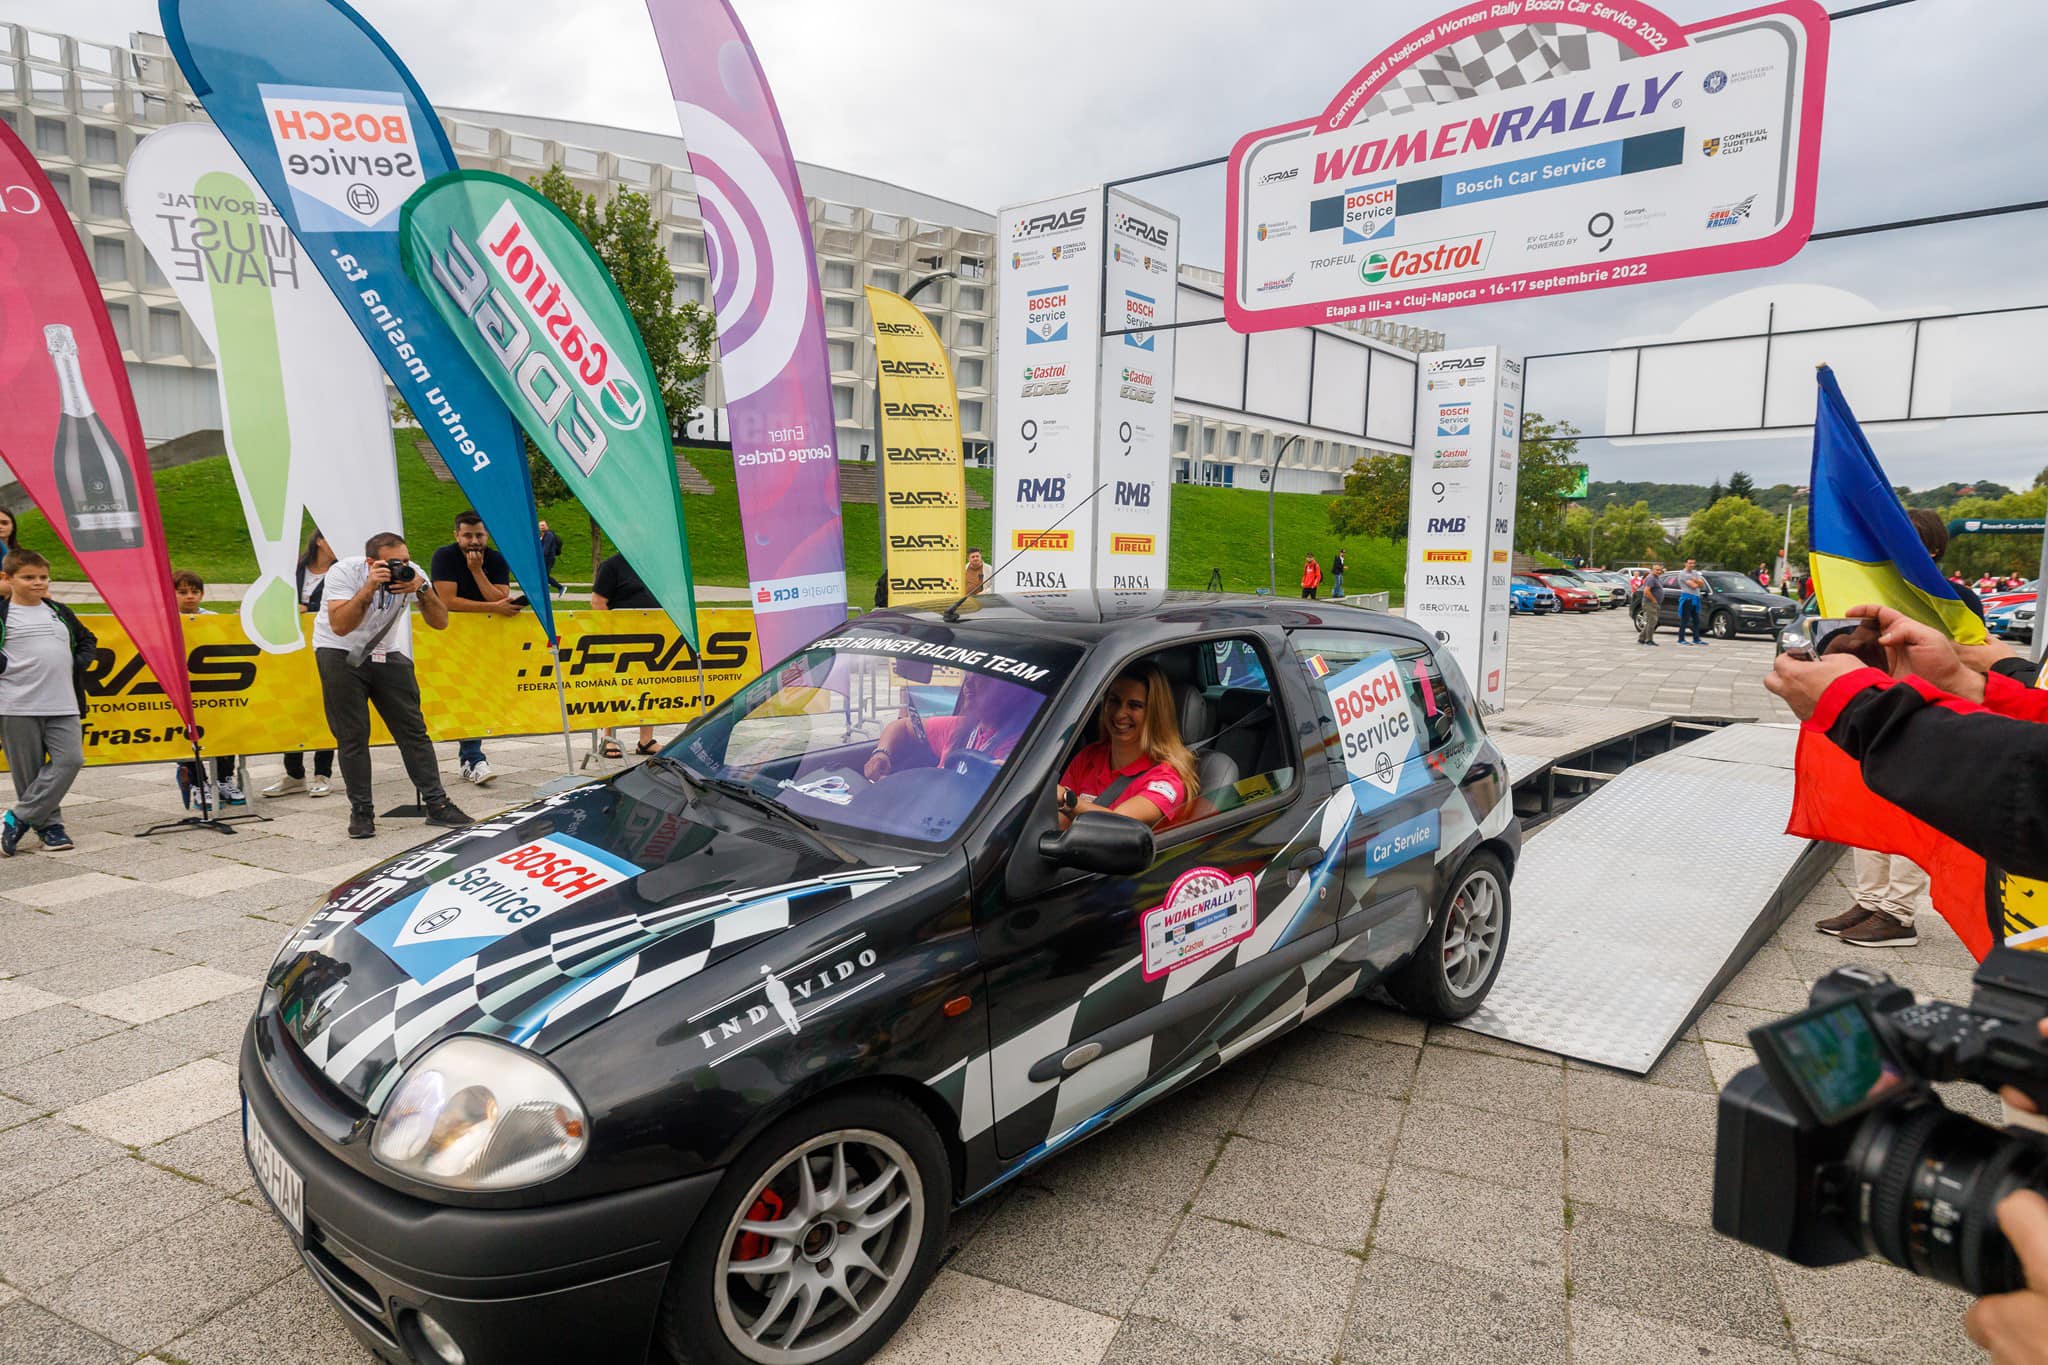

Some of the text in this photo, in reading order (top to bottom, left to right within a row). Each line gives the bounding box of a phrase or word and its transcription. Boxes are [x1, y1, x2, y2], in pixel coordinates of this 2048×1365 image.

[1329, 62, 1387, 128] Campionatul
[1437, 10, 1487, 36] Women
[1491, 1, 1521, 18] Rally
[1525, 0, 1564, 12] Bosch
[1567, 1, 1588, 13] Car
[1591, 3, 1637, 29] Service
[1636, 23, 1668, 50] 2022
[1456, 157, 1606, 196] Bosch Car Service
[1347, 190, 1394, 209] BOSCH
[1027, 207, 1087, 236] FRAS
[1346, 206, 1393, 223] Service
[1126, 217, 1168, 246] FRAS
[1538, 232, 1565, 241] CLASS
[1526, 238, 1565, 250] POWERED
[1310, 254, 1356, 270] TROFEUL
[1390, 238, 1483, 278] Castrol
[1326, 263, 1648, 317] Etapa a III-a Cluj-Napoca 16-17 septembrie 2022
[1029, 295, 1066, 311] BOSCH
[1126, 299, 1154, 318] BOSCH
[1029, 310, 1066, 324] Service
[1034, 364, 1066, 379] Castrol
[1438, 356, 1486, 371] FRAS
[1129, 370, 1153, 386] Castrol
[1439, 415, 1469, 425] Service
[1440, 407, 1469, 417] BOSCH
[1442, 450, 1469, 458] Castrol
[1017, 477, 1066, 502] RMB
[1115, 480, 1150, 507] RMB
[1427, 517, 1466, 533] RMB
[1017, 533, 1069, 549] PIRELLI
[1114, 536, 1152, 553] PIRELLI
[1427, 551, 1468, 561] PIRELLI
[1016, 571, 1067, 589] PARSA
[1113, 575, 1150, 589] PARSA
[1426, 574, 1466, 586] PARSA
[570, 632, 752, 675] FRAS
[914, 642, 988, 665] RACING
[983, 654, 1050, 683] TEAM
[621, 678, 633, 686] DE
[708, 673, 742, 682] SPORTIV
[1335, 671, 1401, 727] BOSCH
[1345, 711, 1410, 759] Service
[1373, 826, 1430, 863] Car Service
[496, 844, 609, 900] BOSCH
[448, 867, 542, 923] Service
